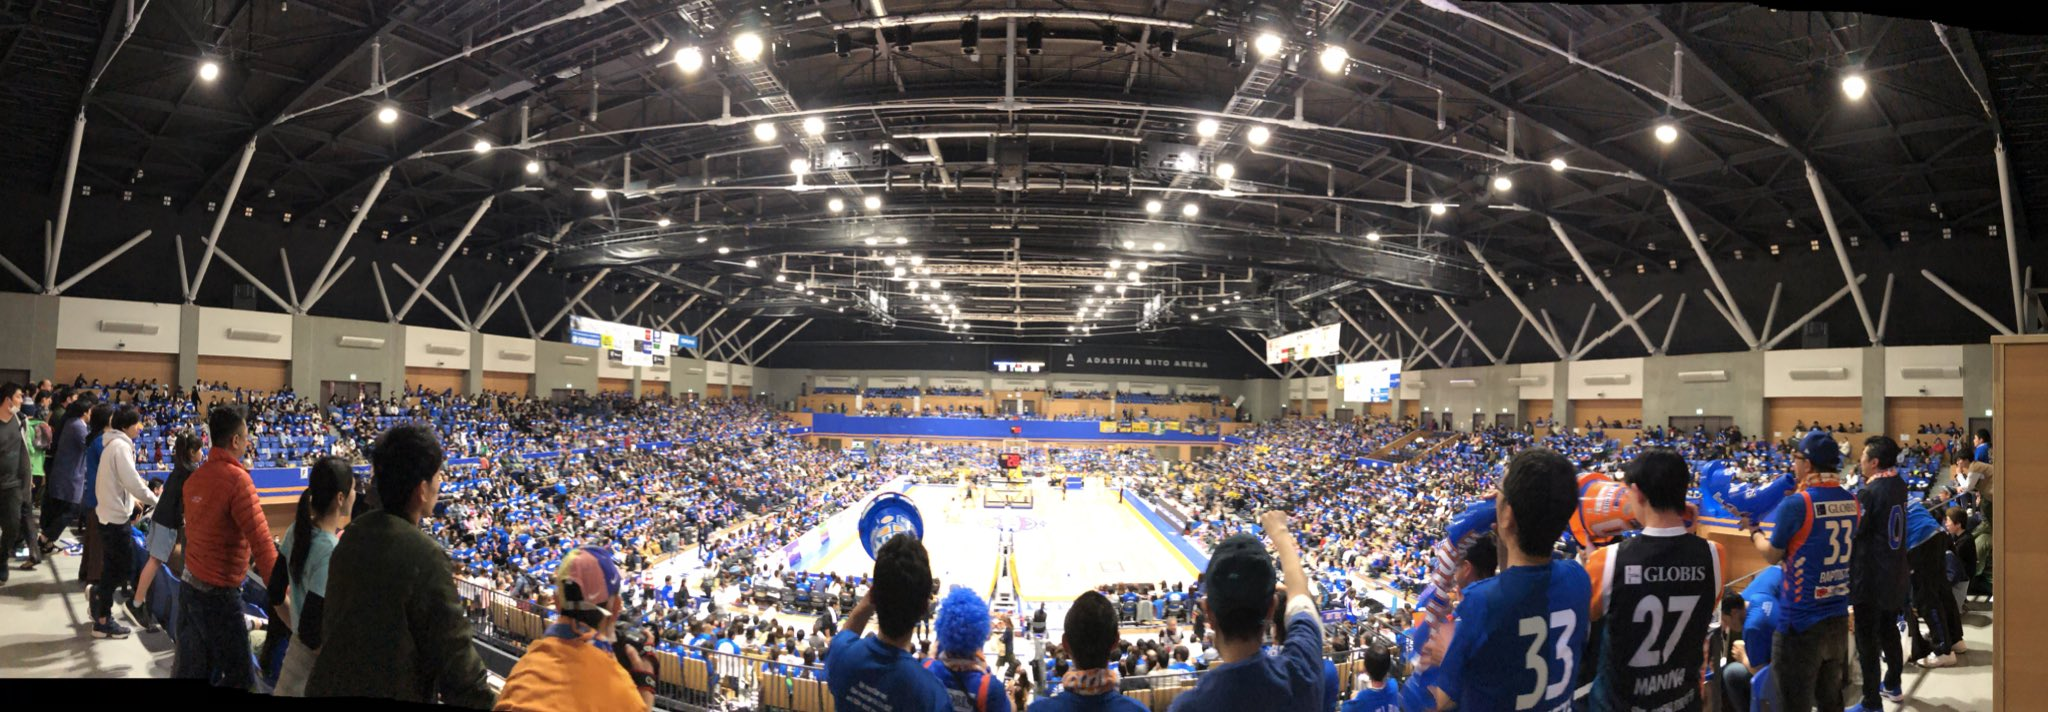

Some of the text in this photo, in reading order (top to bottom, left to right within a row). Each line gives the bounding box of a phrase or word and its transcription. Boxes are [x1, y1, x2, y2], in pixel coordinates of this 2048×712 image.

[1086, 356, 1208, 369] ADASTRIA MITO ARENA
[1823, 519, 1853, 566] 33
[1643, 566, 1706, 582] GLOBIS
[1627, 594, 1701, 668] 27
[1515, 608, 1577, 711] 33
